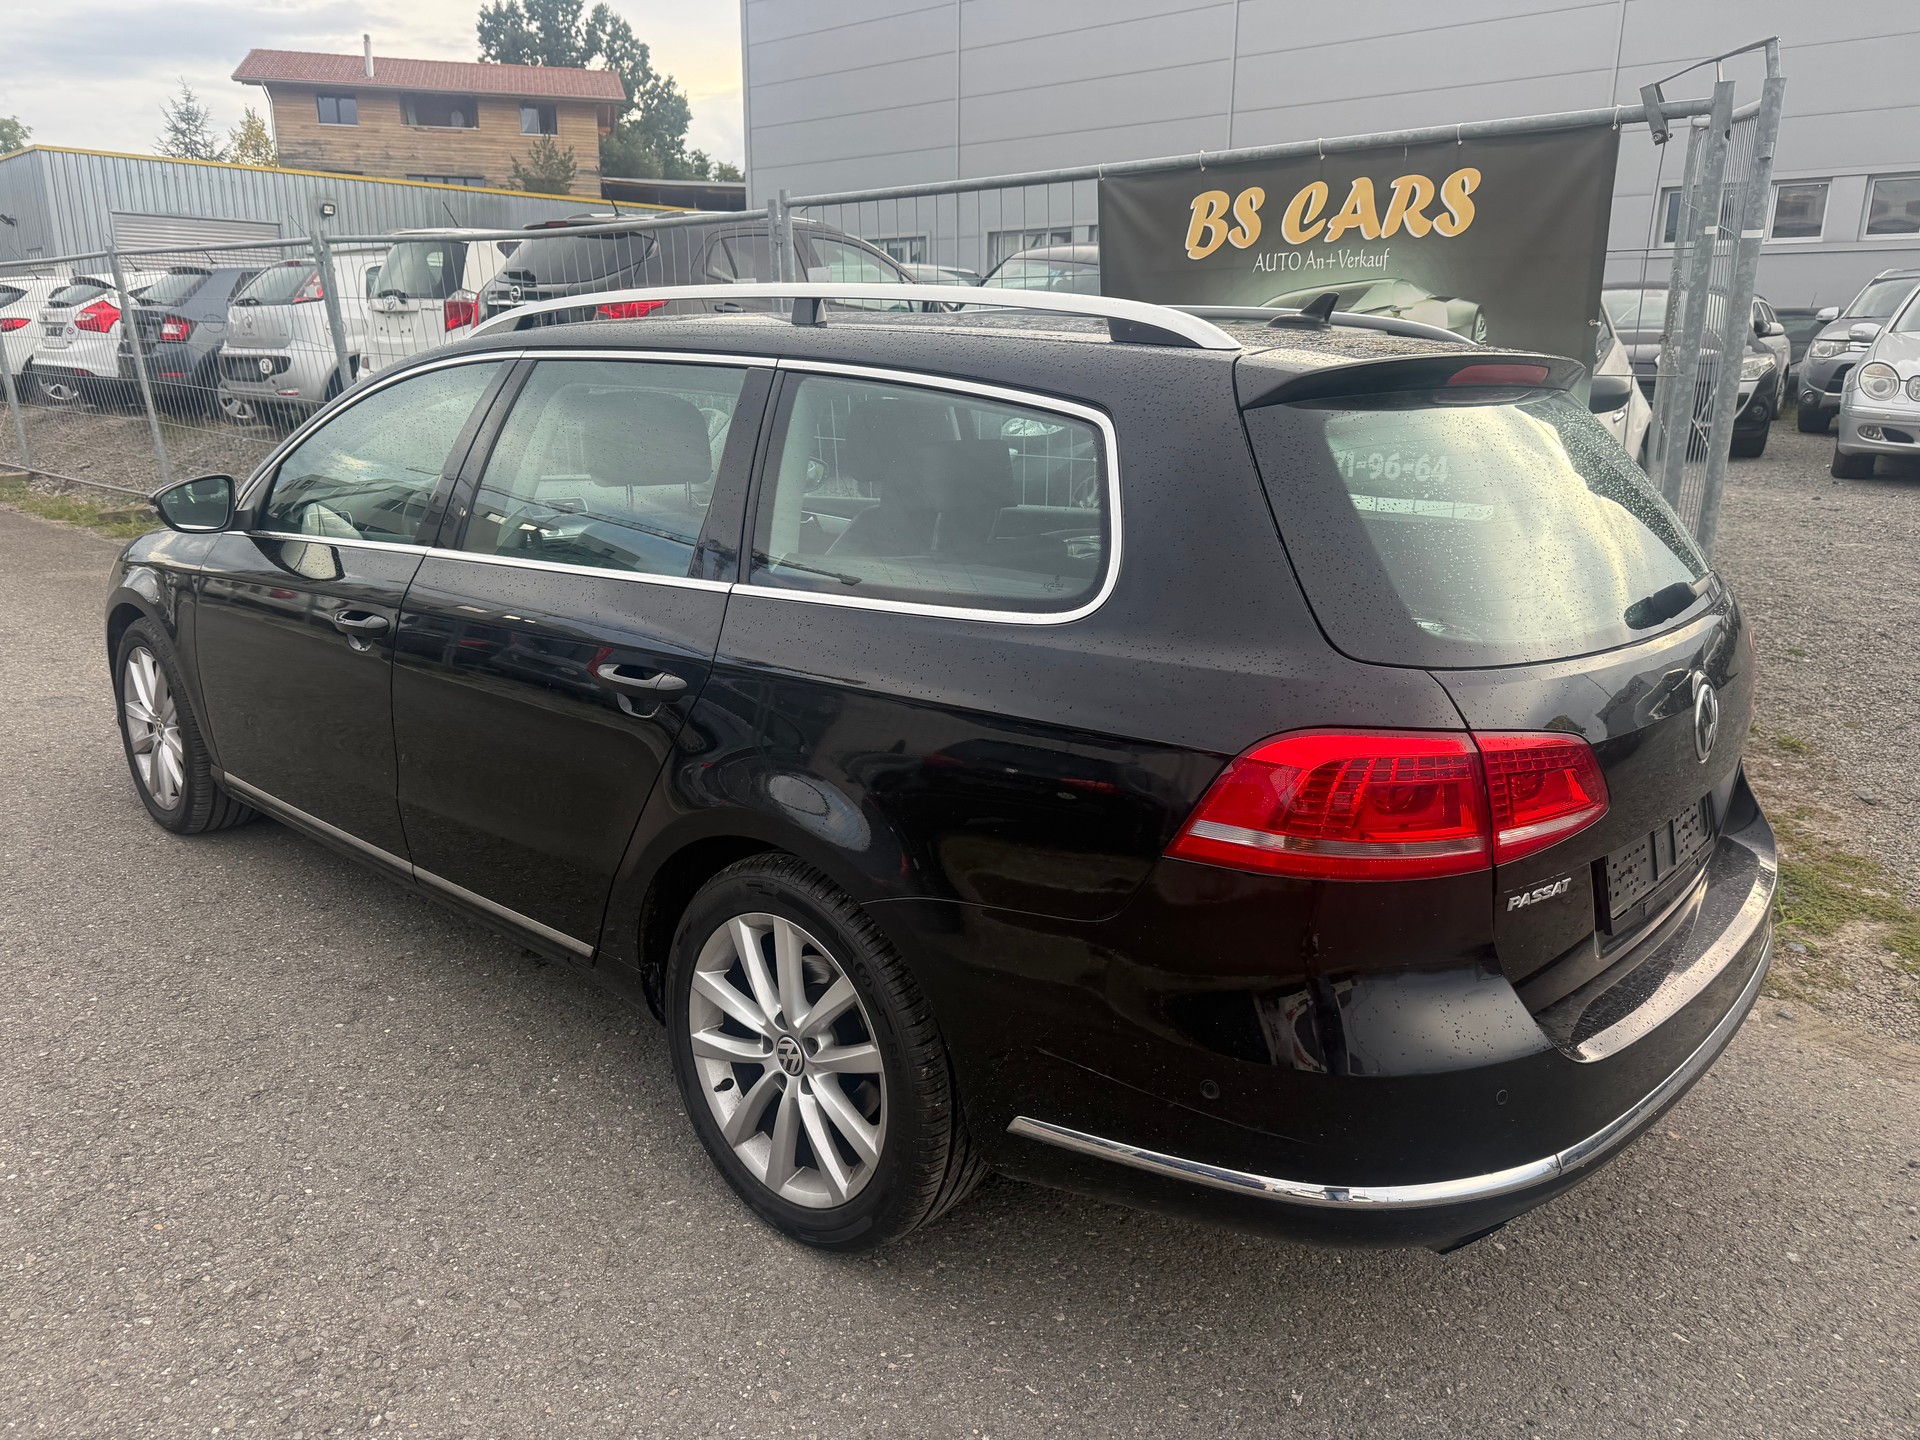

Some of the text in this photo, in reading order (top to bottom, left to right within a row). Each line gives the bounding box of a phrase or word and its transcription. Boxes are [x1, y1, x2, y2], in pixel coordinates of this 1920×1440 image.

[1185, 167, 1482, 260] BS CARS
[1252, 251, 1301, 273] AUTO
[1506, 877, 1572, 912] PASSAT
